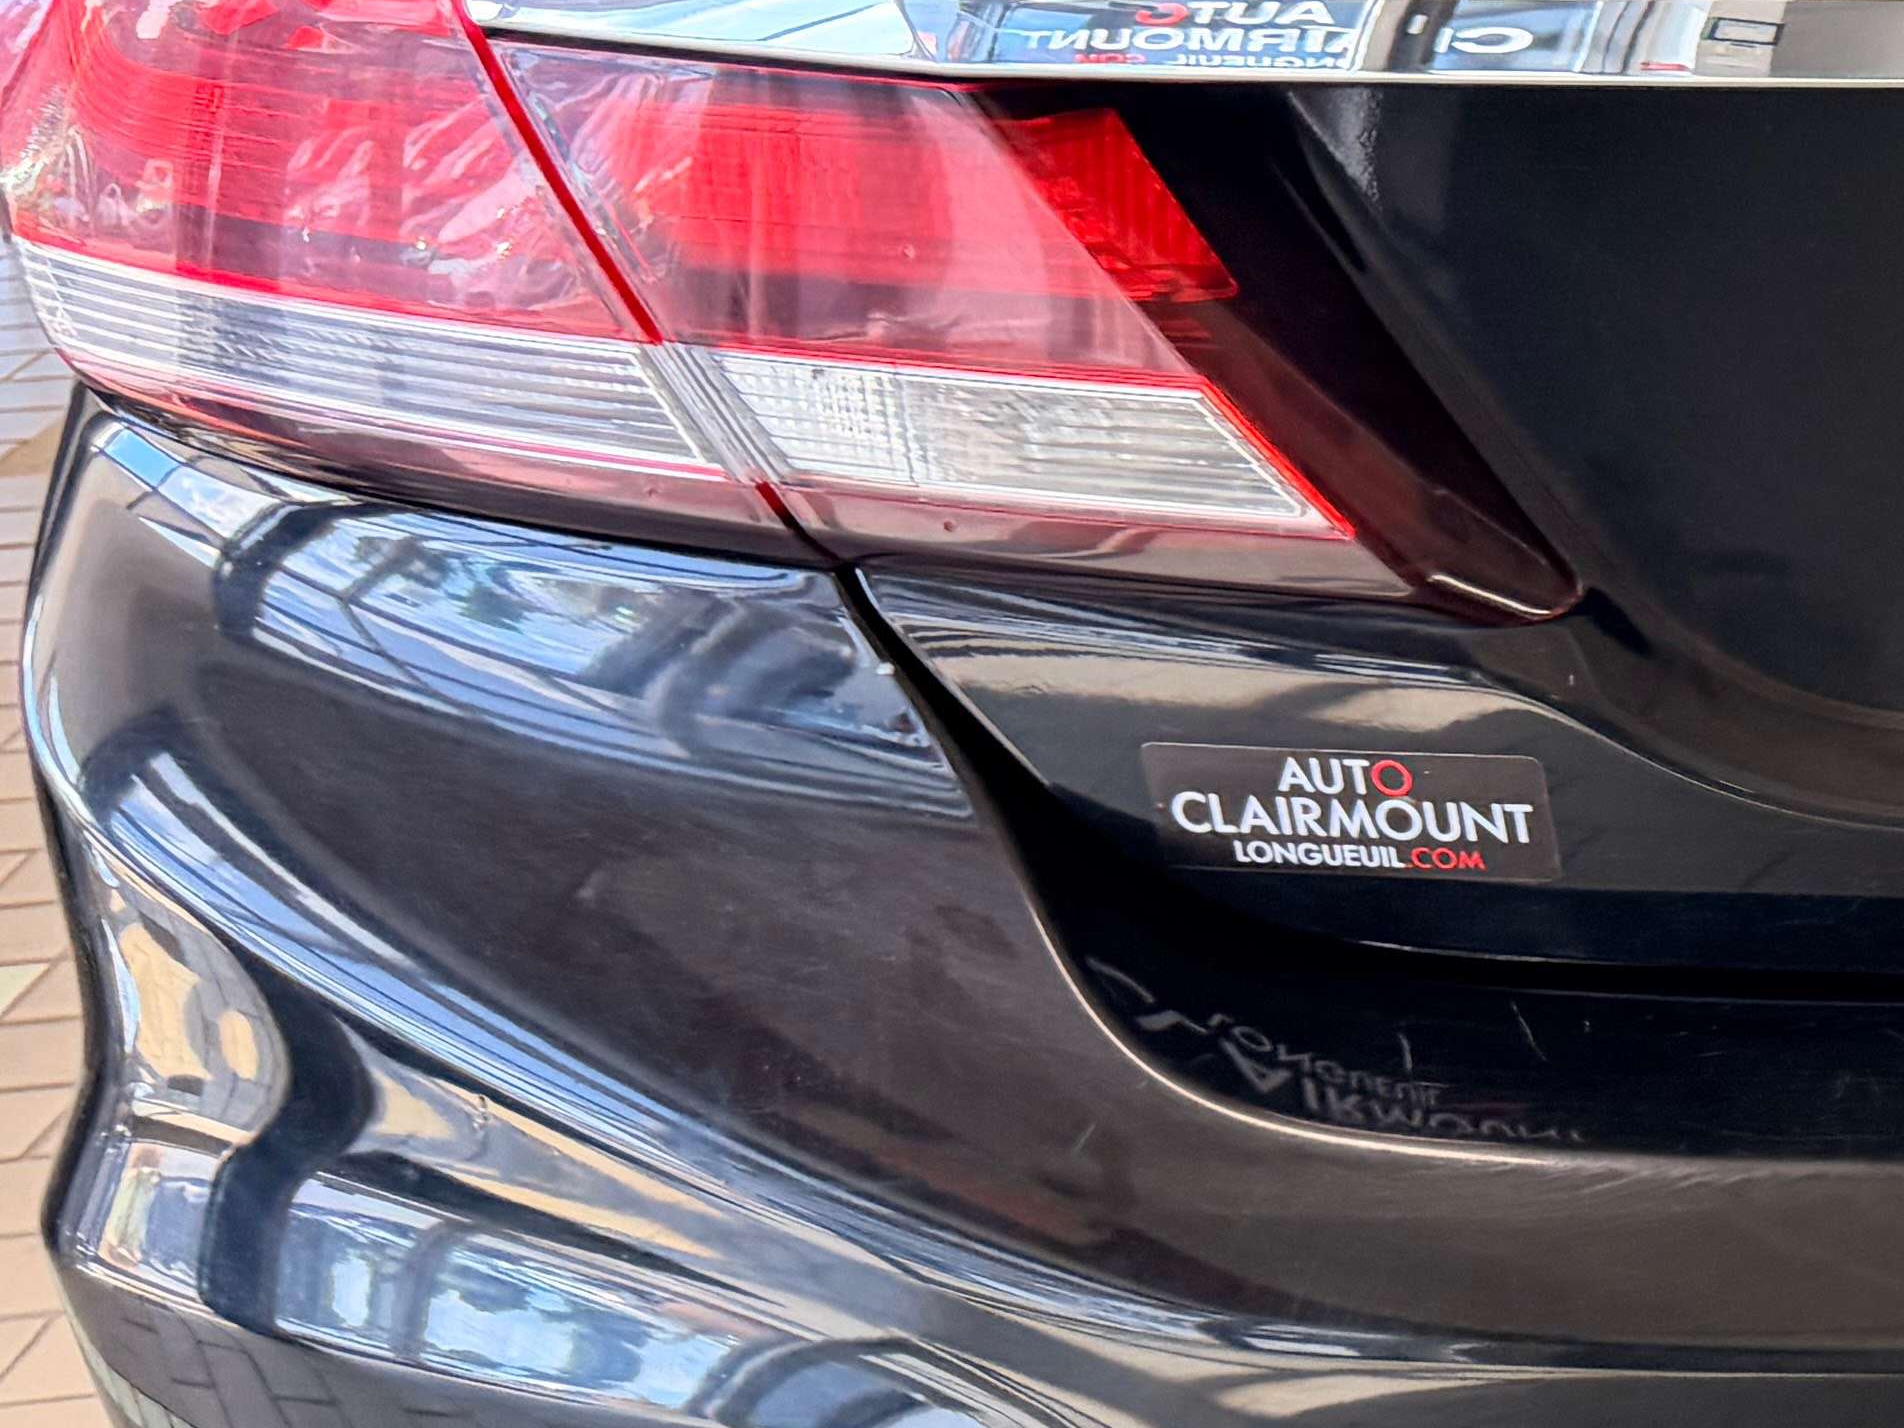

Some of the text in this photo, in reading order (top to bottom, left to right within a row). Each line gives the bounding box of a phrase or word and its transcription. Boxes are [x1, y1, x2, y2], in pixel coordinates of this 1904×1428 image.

[1277, 756, 1414, 798] AUTO
[1170, 790, 1534, 844] CLAIRMOUNT
[1232, 839, 1487, 871] LONGUEUIL.COM
